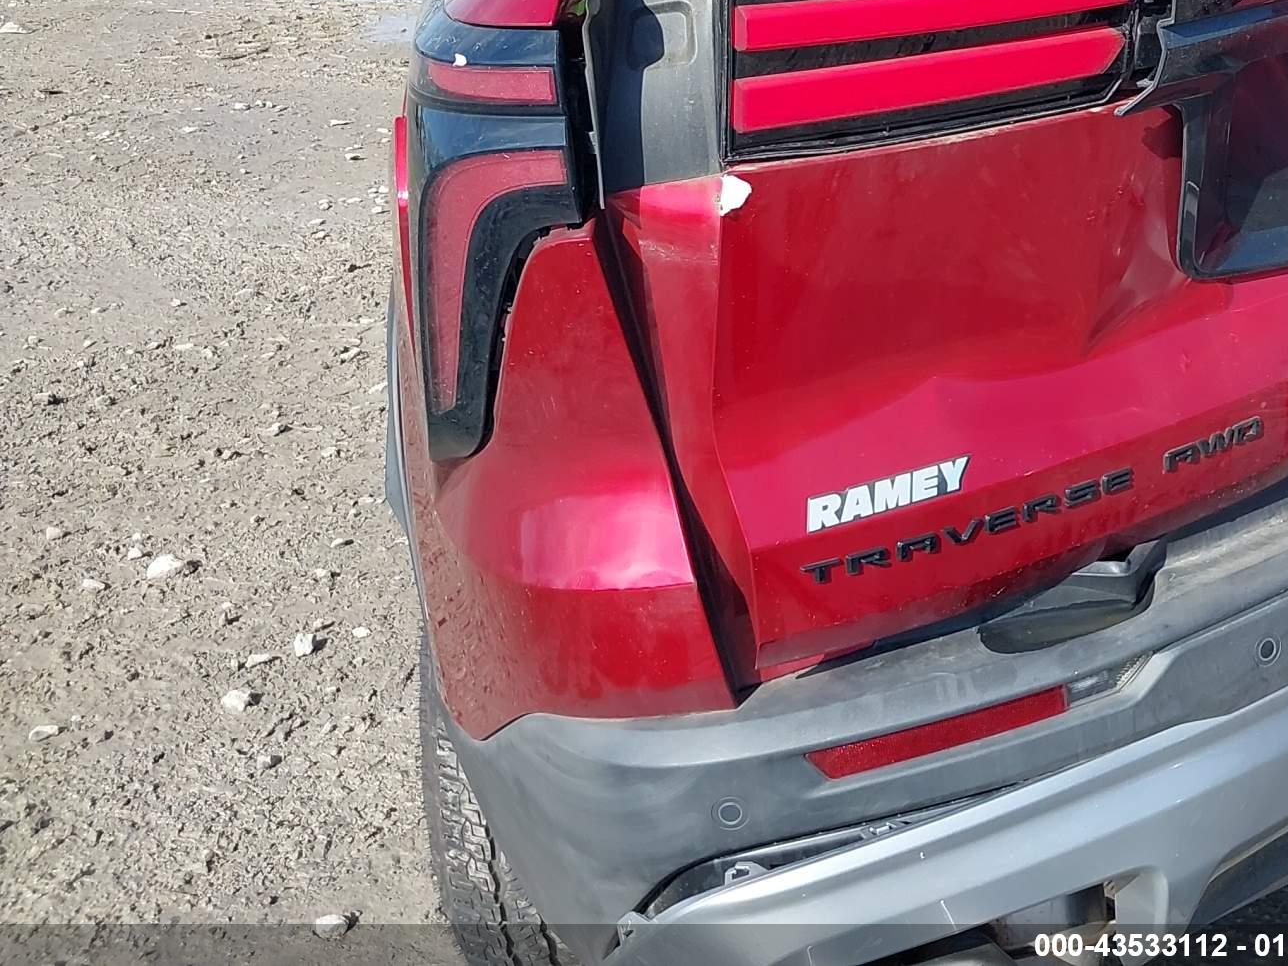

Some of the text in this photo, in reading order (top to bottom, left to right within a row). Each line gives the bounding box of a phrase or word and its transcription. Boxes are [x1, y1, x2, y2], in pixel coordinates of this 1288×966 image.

[801, 416, 1265, 583] TRAVERSE AWD
[806, 456, 970, 533] RAMEY
